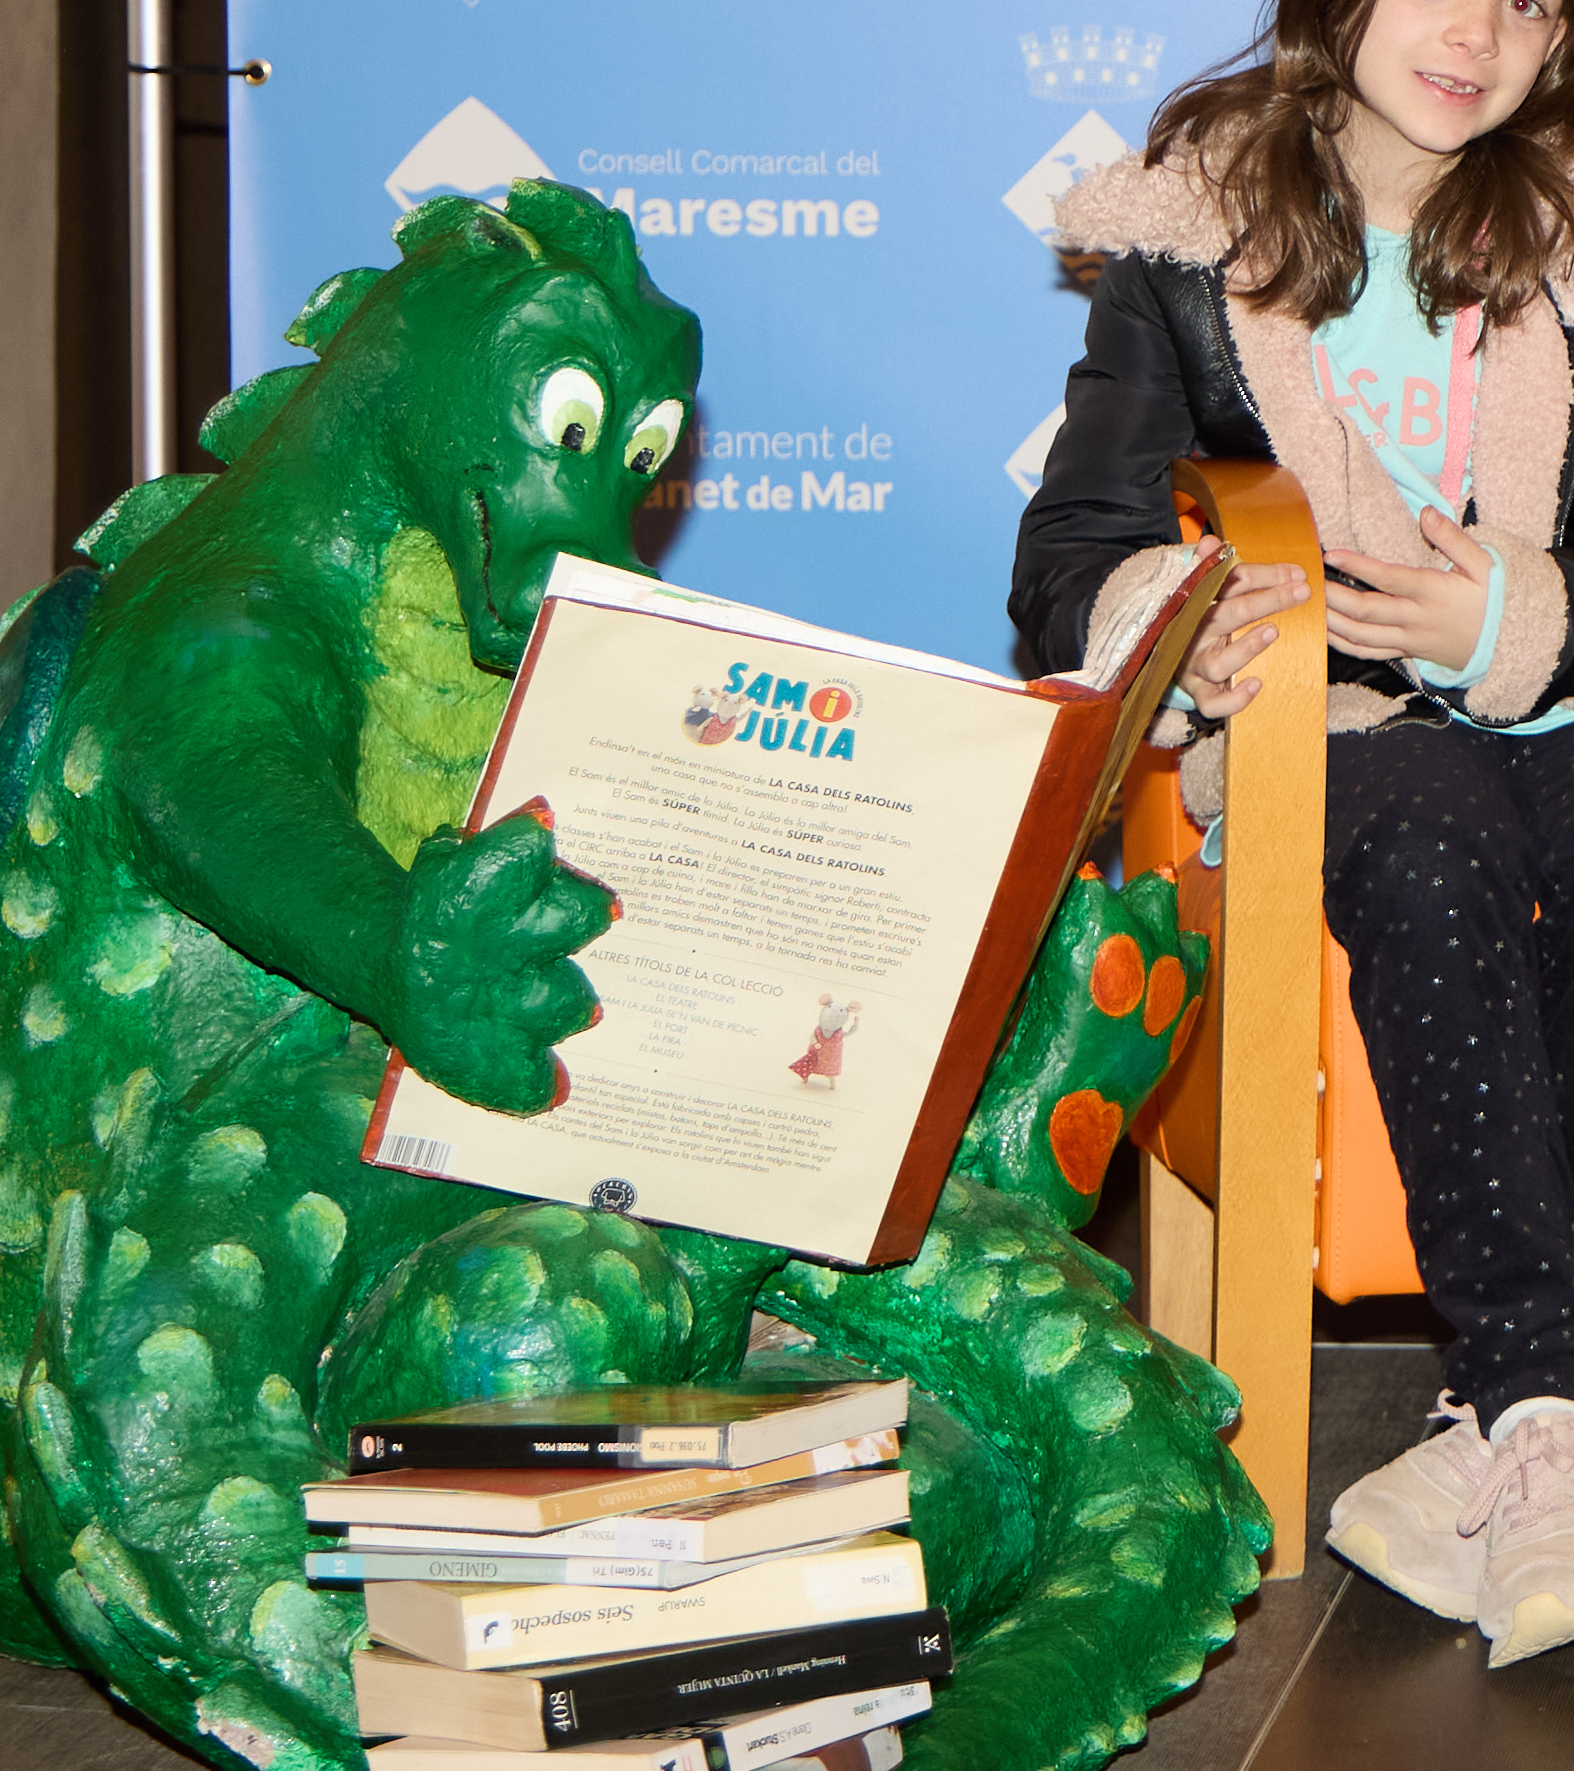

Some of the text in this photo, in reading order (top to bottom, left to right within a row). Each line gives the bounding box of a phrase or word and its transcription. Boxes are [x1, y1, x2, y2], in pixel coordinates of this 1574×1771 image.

[578, 148, 880, 176] Consell Comarcal del
[844, 423, 893, 460] de
[644, 471, 893, 511] anet de Mar
[722, 662, 809, 712] SAM
[734, 712, 856, 761] JÚLIA
[589, 736, 635, 754] Endinsa't
[663, 753, 686, 765] món
[752, 774, 767, 785] de
[768, 777, 784, 788] LA
[786, 780, 820, 795] CASA
[822, 786, 851, 800] DELS
[650, 764, 671, 775] una
[672, 770, 696, 781] casa
[588, 947, 631, 966] ALTRES
[674, 965, 692, 978] DE
[693, 968, 710, 982] LA
[533, 1442, 590, 1452] PHOEBE POOL
[428, 1561, 498, 1578] GIMENO
[596, 1603, 634, 1625] Seis
[657, 1595, 706, 1612] SWARUP
[810, 1653, 847, 1670] Henning
[677, 1677, 713, 1696] MUJER
[714, 1669, 755, 1687] QUINTA
[755, 1668, 769, 1683] LA
[550, 1690, 572, 1731] 408
